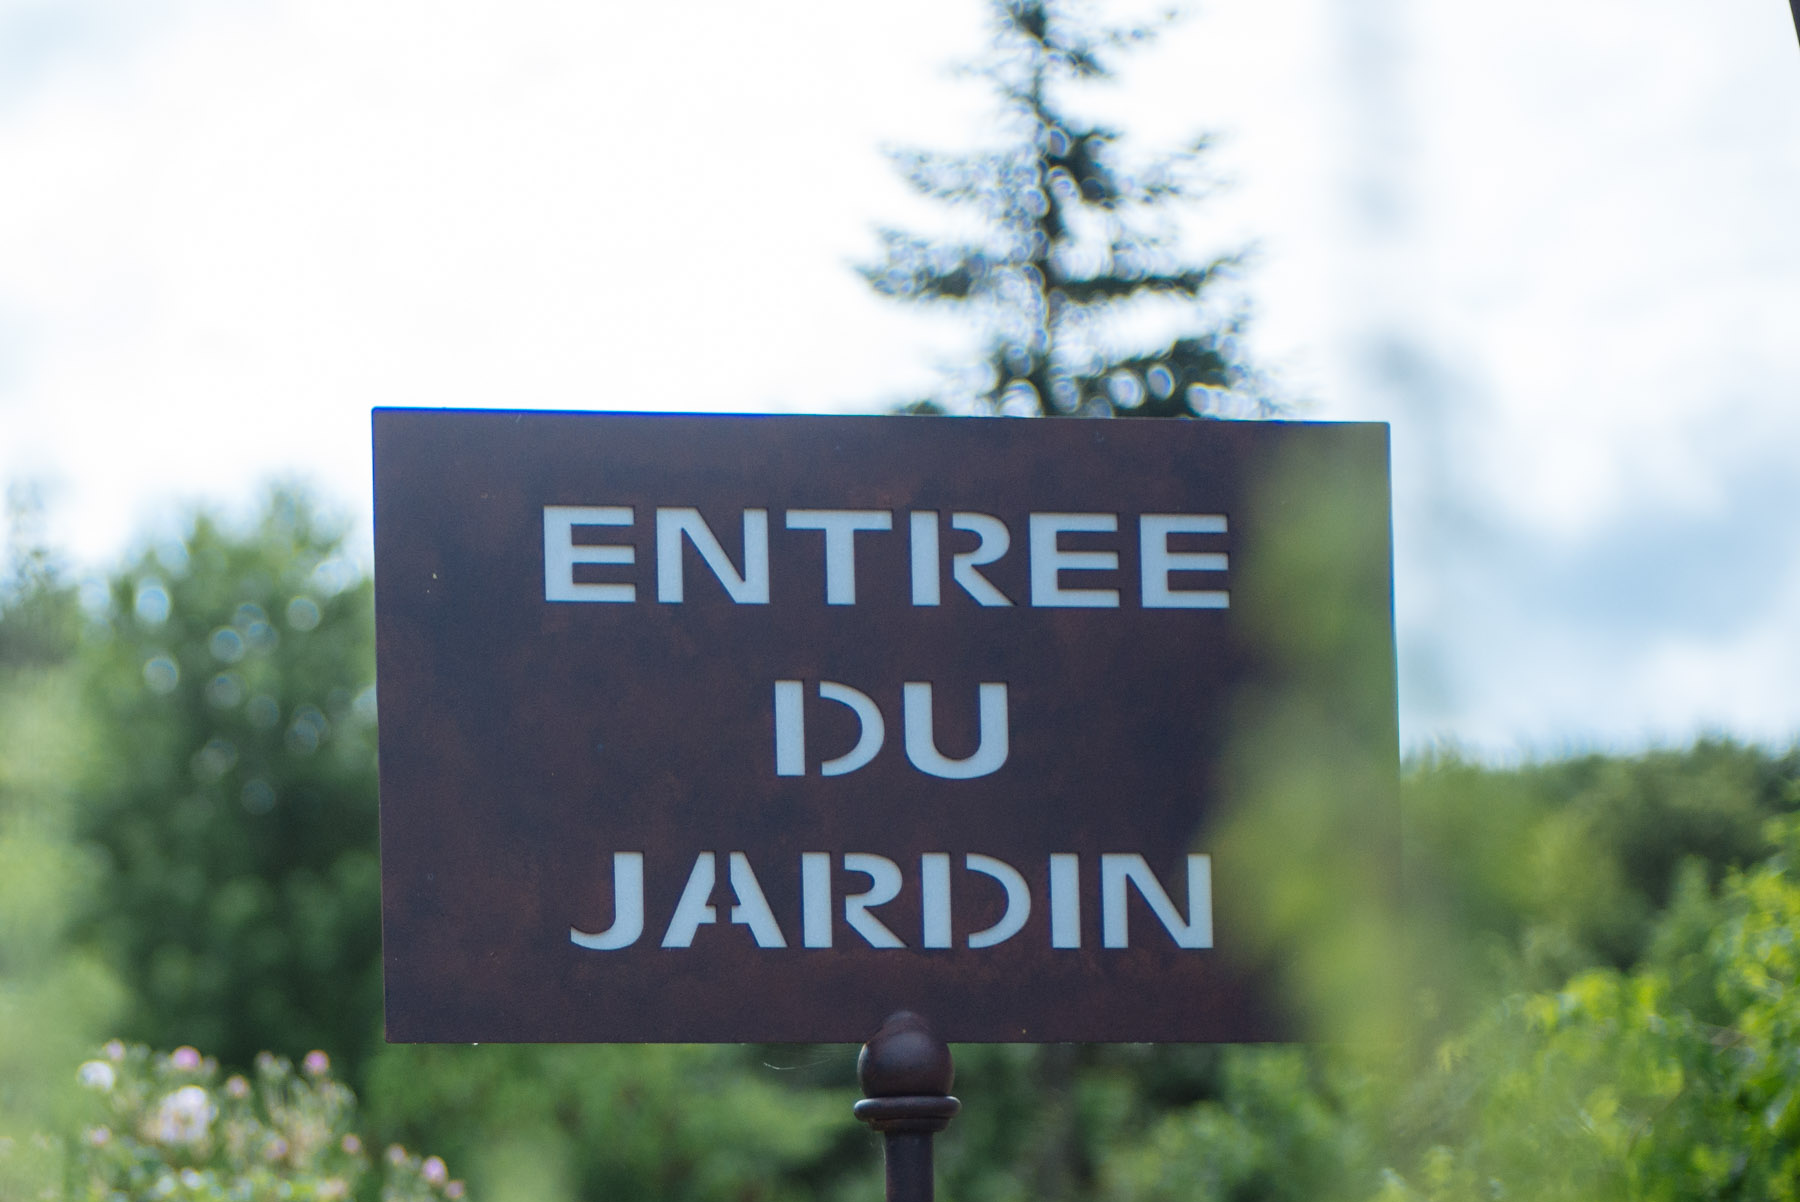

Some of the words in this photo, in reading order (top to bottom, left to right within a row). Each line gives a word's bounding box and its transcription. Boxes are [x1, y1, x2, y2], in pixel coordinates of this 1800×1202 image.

[542, 505, 1231, 608] ENTREE
[774, 679, 1010, 779] DU
[569, 851, 1215, 951] JARDIN
